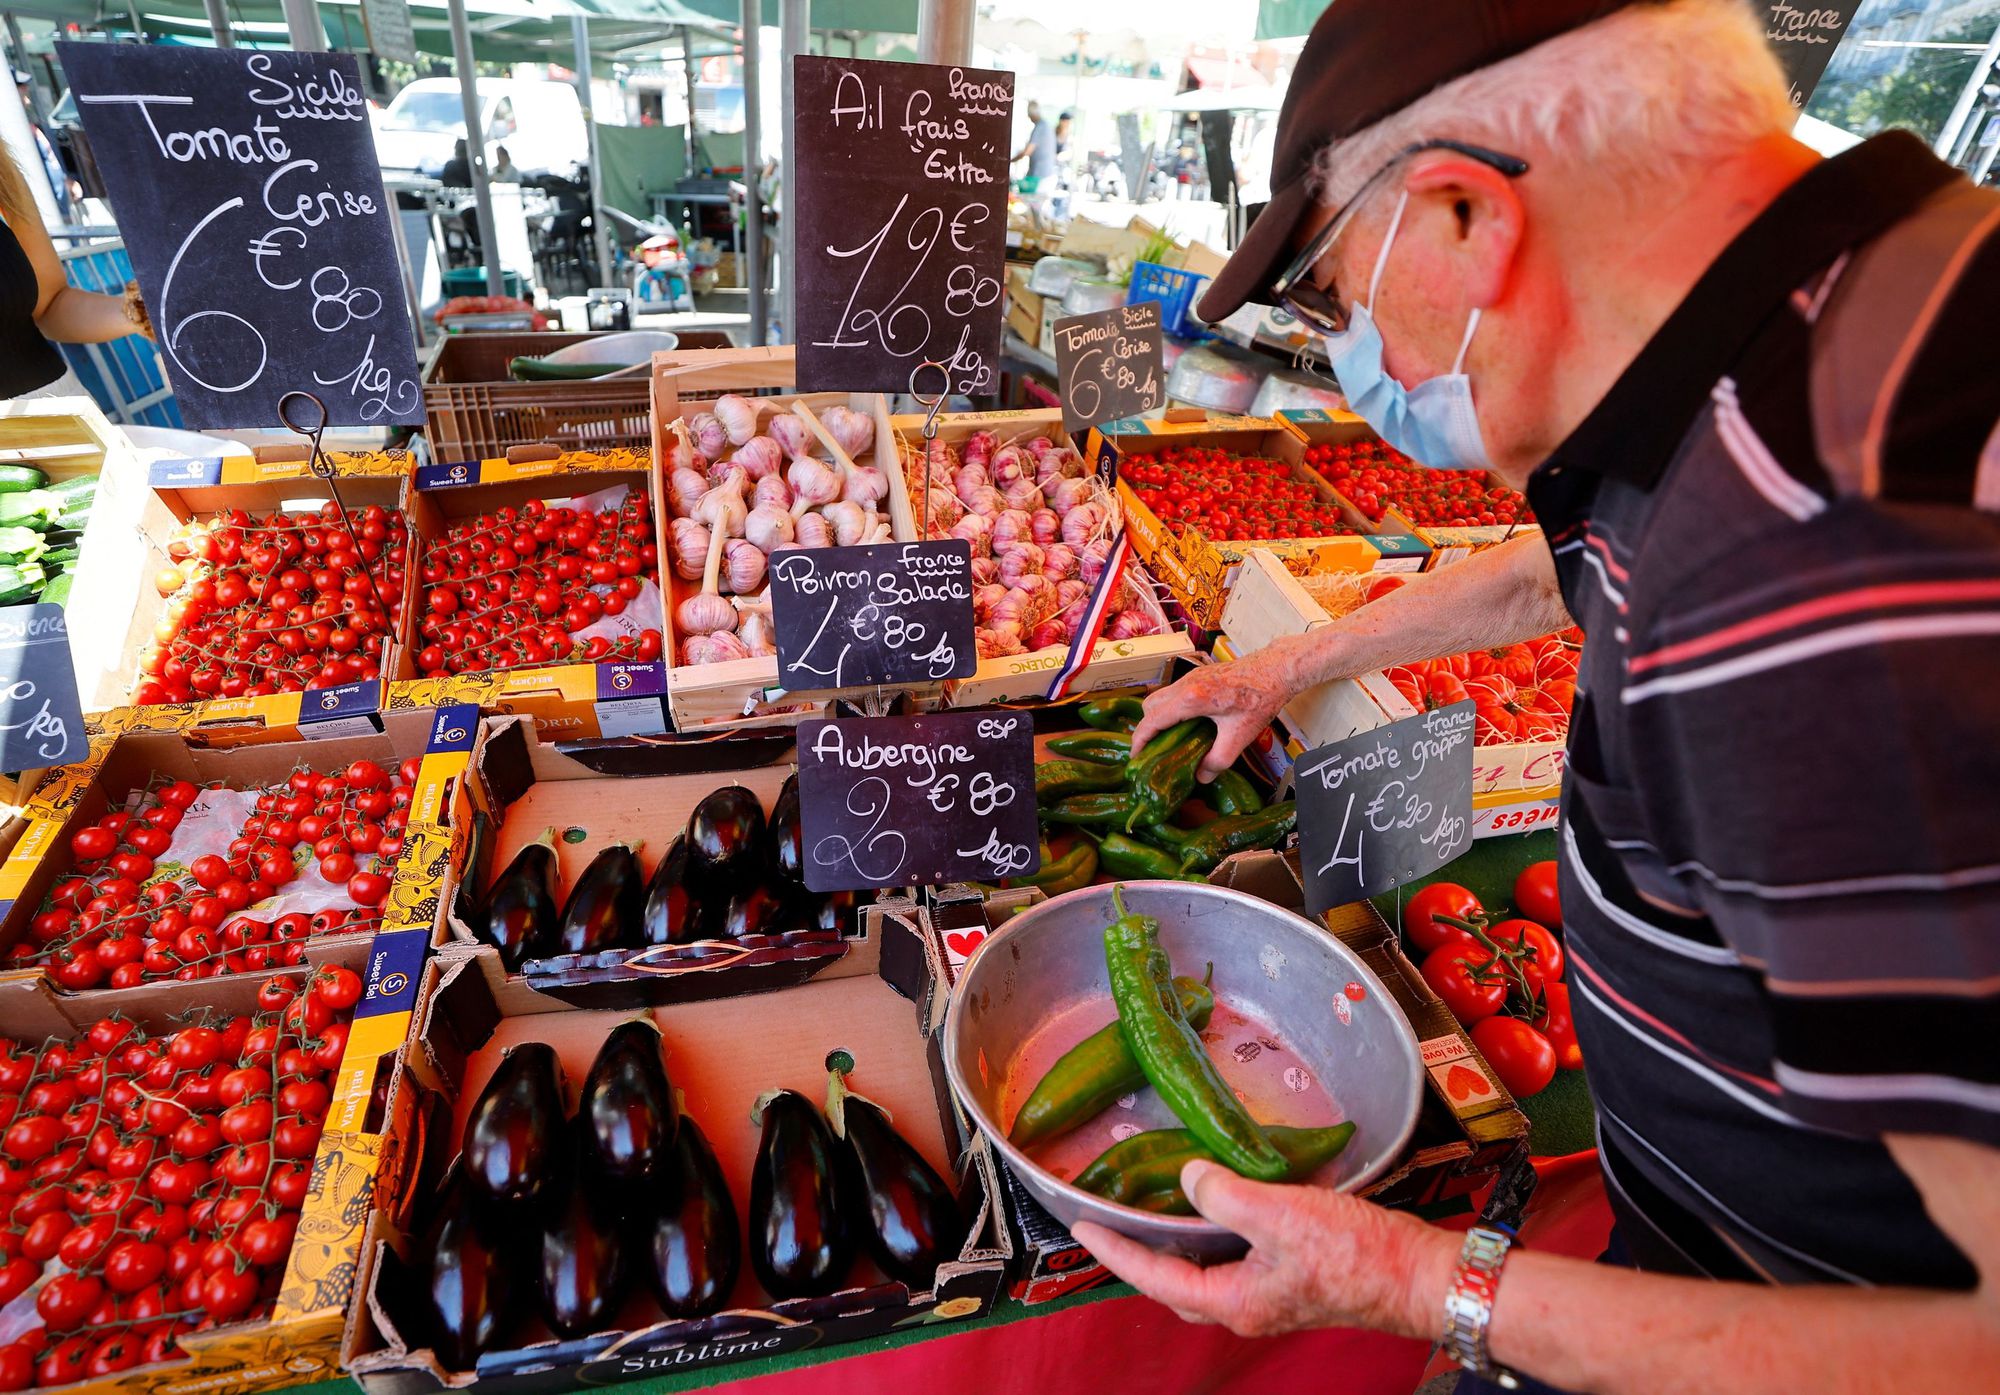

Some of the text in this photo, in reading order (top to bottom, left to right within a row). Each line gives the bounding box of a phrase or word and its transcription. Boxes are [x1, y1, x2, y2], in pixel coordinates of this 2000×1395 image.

[247, 54, 364, 106] Sicile
[830, 72, 971, 140] Ail frais
[80, 94, 291, 164] Tomate
[263, 159, 377, 227] Cerise
[160, 196, 383, 393] 6 € 80
[812, 193, 1000, 357] 12 € 80
[1055, 323, 1120, 352] Tomate
[1121, 306, 1153, 325] Sicile
[924, 323, 991, 395] kg
[1113, 336, 1152, 359] Cerise
[313, 334, 419, 421] kg
[1069, 348, 1157, 419] 6 € 80 kg
[429, 479, 453, 487] Sweet
[776, 555, 971, 607] Poivron Salade
[787, 595, 956, 688] 4 € 80 kg
[335, 686, 360, 697] Sweet
[611, 664, 654, 674] Sweet Bel
[437, 714, 449, 735] Sweet
[536, 716, 584, 730] ORTA
[811, 724, 976, 787] Aubergine
[1300, 732, 1467, 790] Tomate grappe
[813, 772, 1016, 881] 2 € 80
[956, 826, 1032, 876] kg
[1317, 780, 1466, 888] 4 € 20 kg
[365, 951, 388, 1000] Sweet Bel
[1420, 1035, 1460, 1052] VEGETABLES
[1423, 1044, 1466, 1060] We love
[621, 1335, 782, 1374] Sublime
